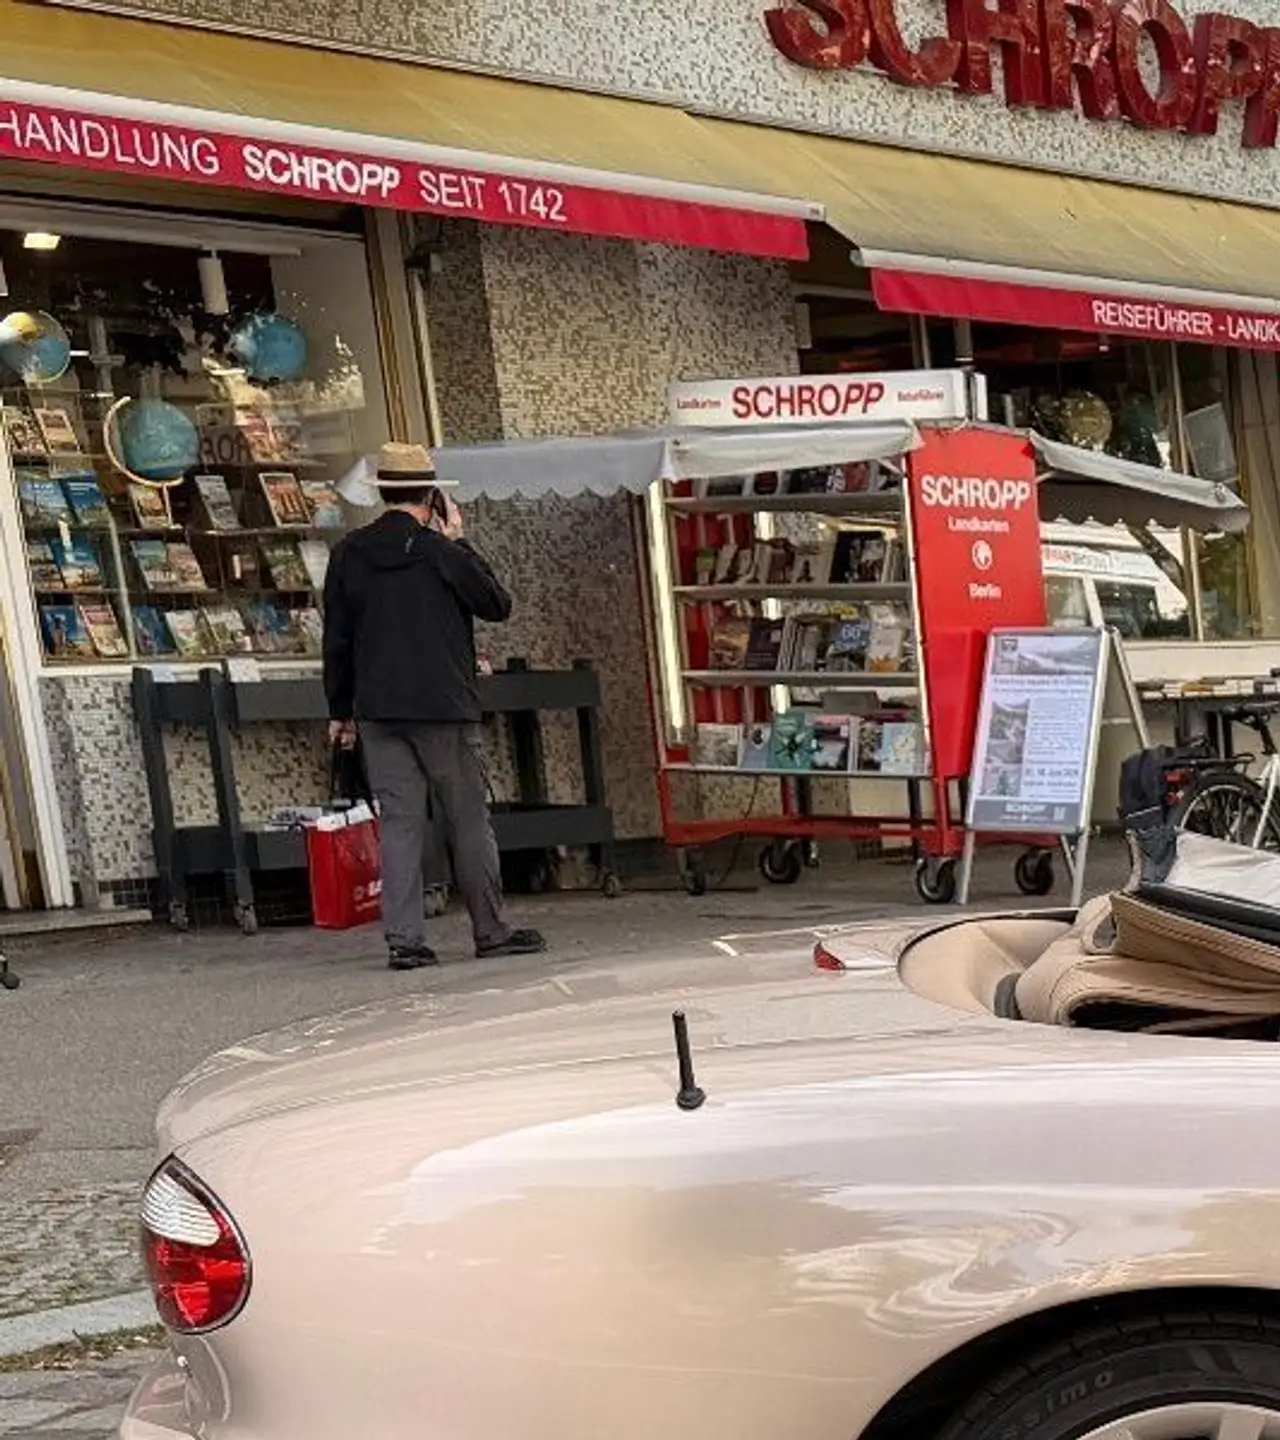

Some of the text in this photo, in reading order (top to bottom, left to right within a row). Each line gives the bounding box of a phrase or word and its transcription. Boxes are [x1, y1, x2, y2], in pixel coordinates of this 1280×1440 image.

[242, 144, 400, 198] SCHROPP
[418, 170, 486, 210] SEIT
[498, 182, 567, 222] 1742
[1092, 300, 1213, 336] REISEFÜHRER
[732, 381, 884, 419] SCHROPP
[921, 474, 1031, 511] SCHROPP
